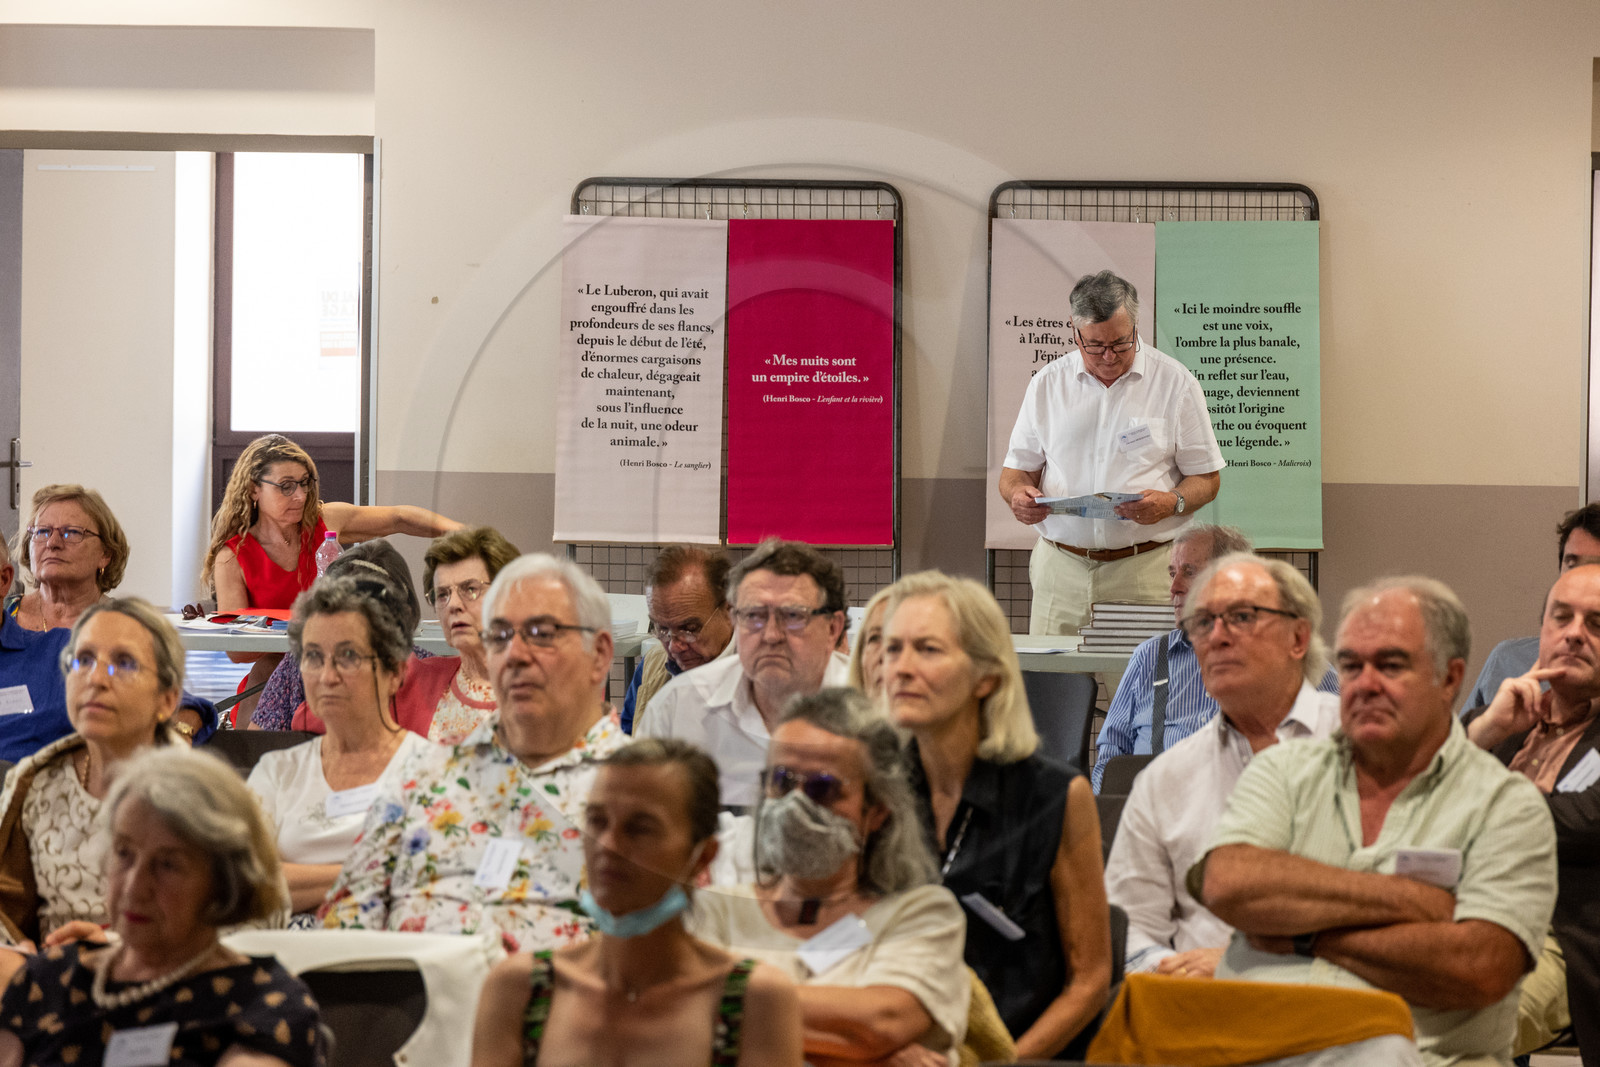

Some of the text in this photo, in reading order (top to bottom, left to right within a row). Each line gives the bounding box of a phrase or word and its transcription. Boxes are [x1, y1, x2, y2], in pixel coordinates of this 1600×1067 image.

[586, 284, 601, 296] Le
[604, 284, 656, 299] Luberon,
[660, 288, 678, 301] qui
[681, 289, 709, 299] avait
[591, 302, 694, 315] engouffré dans les
[1182, 303, 1197, 314] Ici
[1200, 303, 1210, 314] le
[1213, 303, 1261, 314] moindre
[1263, 302, 1302, 314] souffle
[570, 317, 714, 334] profondeurs de ses flancs,
[1013, 316, 1033, 327] Les
[1036, 317, 1063, 328] êtres
[1203, 322, 1219, 331] est
[1245, 320, 1273, 332] voix,
[577, 334, 706, 350] depuis le début de l’été,
[1019, 333, 1026, 343] à
[1028, 333, 1065, 347] l’affût,
[1175, 336, 1300, 350] l’ombre la plus banale,
[581, 351, 701, 367] d’énormes cargaisons
[773, 354, 798, 366] Mes
[800, 356, 829, 366] nuits
[832, 356, 856, 366] sont
[1032, 350, 1067, 364] J’épi
[1224, 353, 1277, 367] présence.
[581, 368, 701, 385] de chaleur, dégageait
[770, 372, 810, 386] empire
[812, 371, 861, 383] d’étoiles.
[1208, 369, 1237, 381] reflet
[1240, 372, 1258, 381] sur
[1260, 369, 1289, 382] l’eau,
[605, 386, 675, 400] maintenant,
[763, 394, 788, 403] (Henri
[817, 395, 843, 405] L’enfant
[859, 395, 883, 404] rivière)
[1203, 386, 1300, 400] uage, deviennent
[596, 402, 684, 414] sous l’influence
[1207, 402, 1285, 416] ssitôt l’origine
[581, 417, 699, 432] de la nuit, une odeur
[1254, 420, 1307, 433] évoquent
[610, 436, 660, 447] animale.
[1235, 436, 1282, 450] légende.
[620, 459, 645, 467] (Henri
[646, 460, 668, 468] Bosco
[684, 461, 712, 471] sanglier)
[1250, 459, 1272, 467] Bosco
[1278, 459, 1312, 468] Malicroix)
